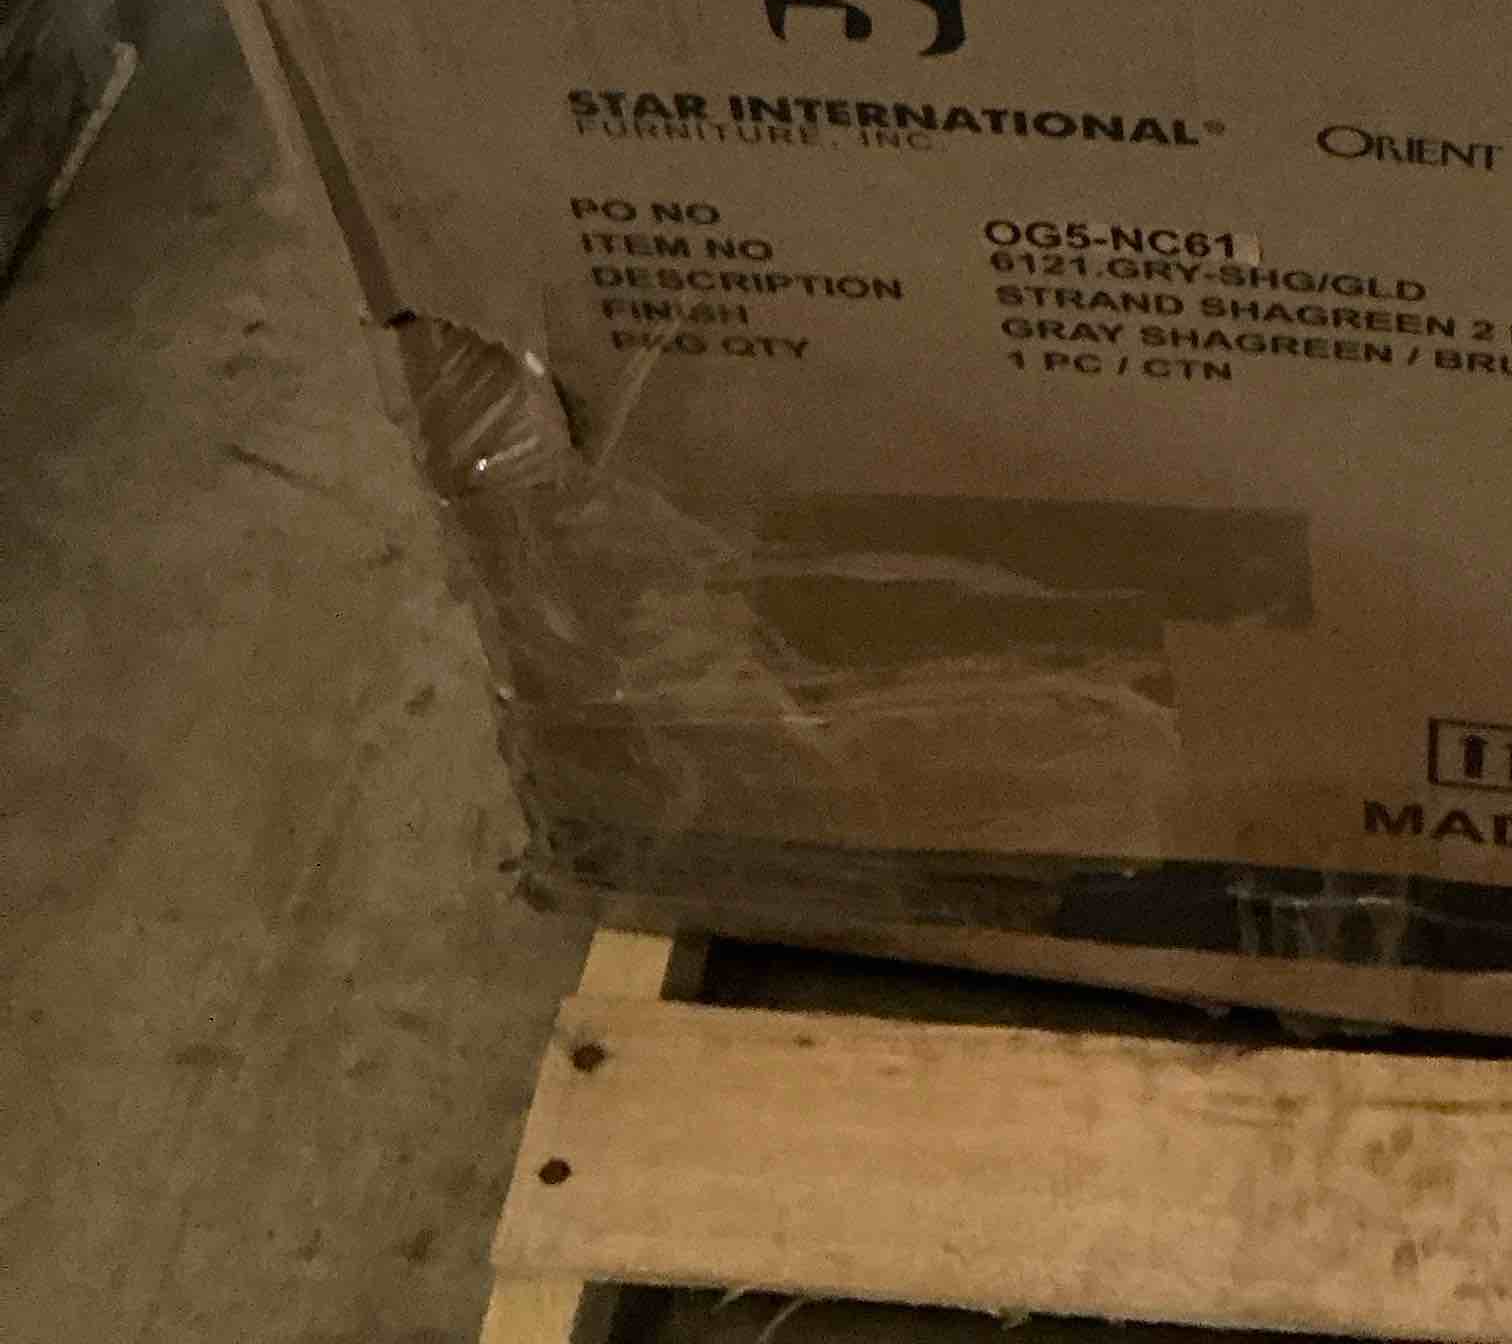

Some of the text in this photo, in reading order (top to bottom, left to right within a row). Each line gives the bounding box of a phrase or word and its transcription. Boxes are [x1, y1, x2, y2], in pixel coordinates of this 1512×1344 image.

[567, 90, 707, 120] STAR
[569, 196, 721, 225] PO NO
[582, 232, 774, 262] ITEM NO
[984, 219, 1236, 258] OG5-NC61
[592, 266, 904, 301] DESCRIPTION
[602, 299, 748, 324] FINISH
[995, 285, 1185, 316] STRAND
[1200, 296, 1455, 337] SHAGREEN
[1473, 319, 1495, 341] 2
[721, 335, 808, 358] QTY
[1001, 318, 1124, 344] GRAY
[1141, 325, 1392, 365] SHAGREEN
[1009, 350, 1025, 370] 1
[1045, 352, 1100, 373] PC
[1143, 359, 1232, 381] CTN
